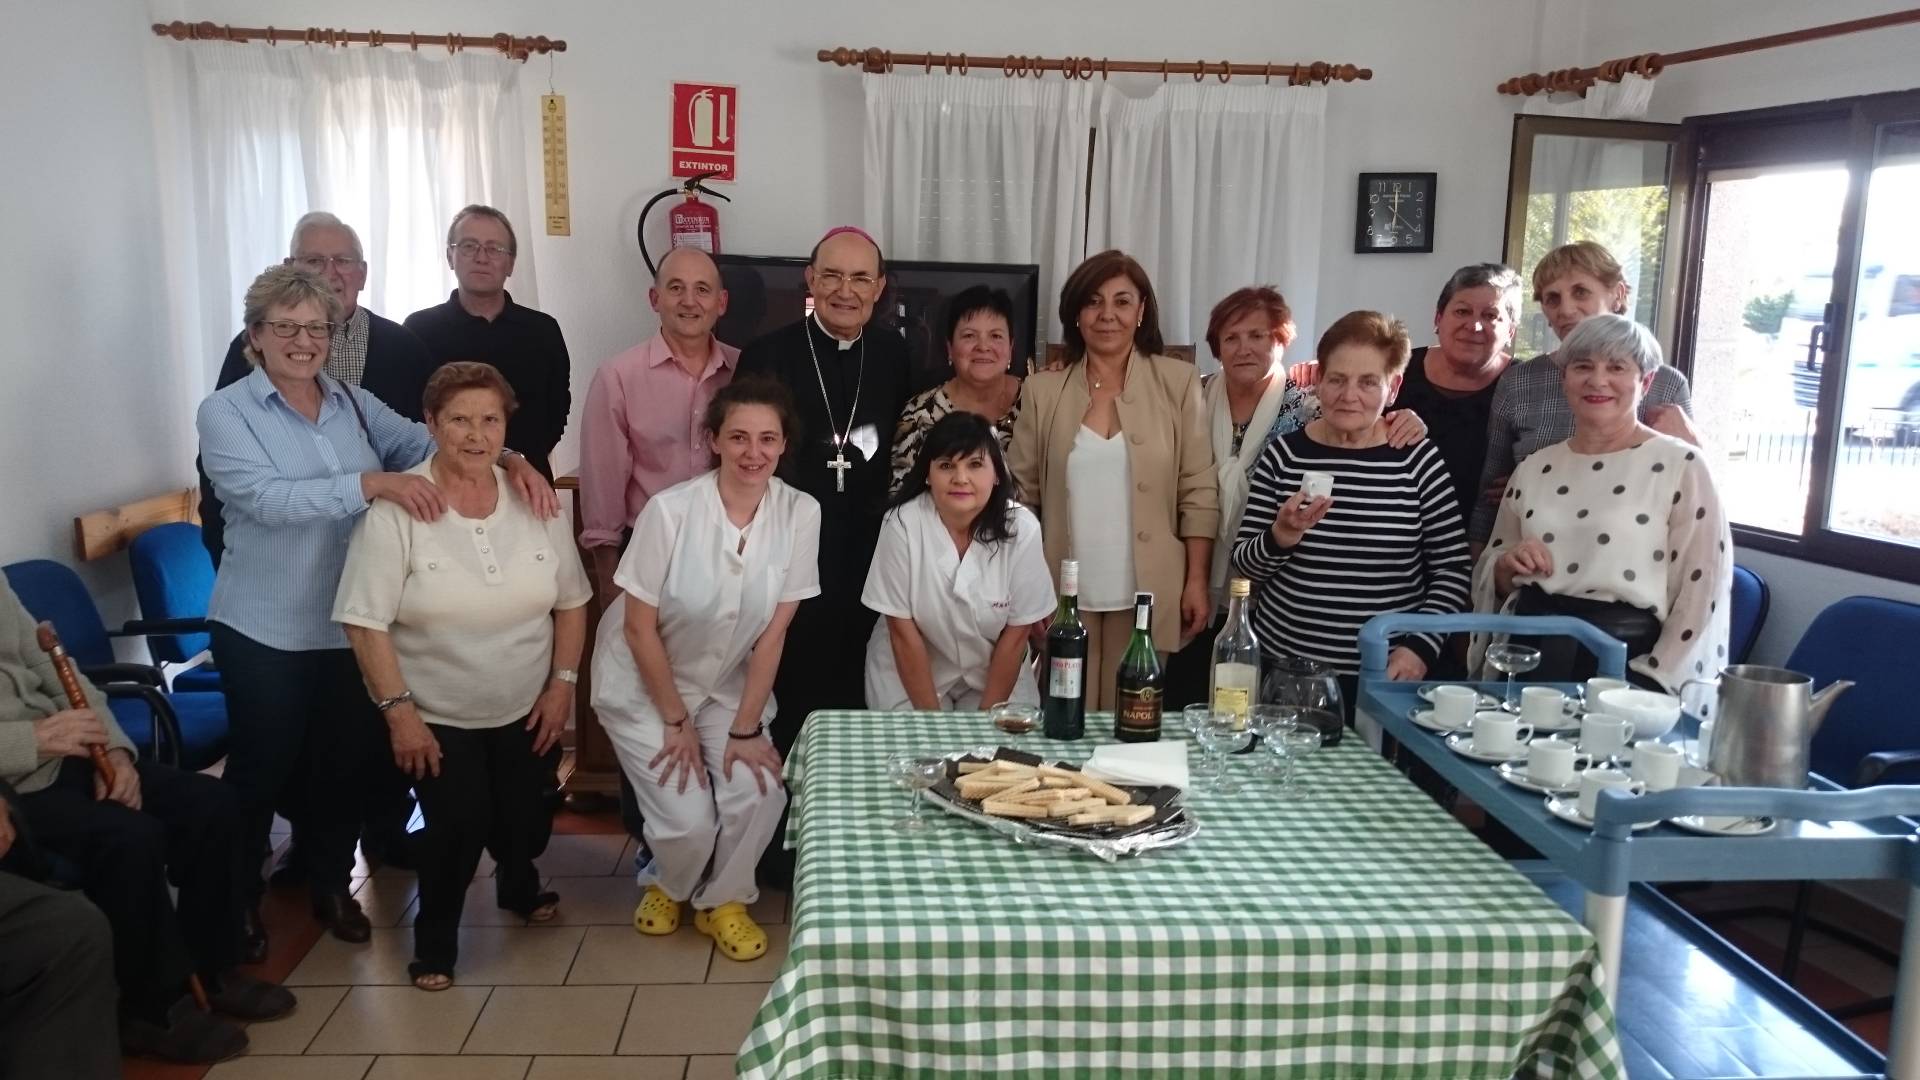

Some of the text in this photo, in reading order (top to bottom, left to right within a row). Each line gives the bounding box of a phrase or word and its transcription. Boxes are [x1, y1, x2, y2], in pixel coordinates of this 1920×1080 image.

[679, 160, 728, 172] EXTINTOR
[1378, 181, 1386, 193] 11
[1408, 182, 1413, 193] 1
[1369, 193, 1380, 204] 10
[1416, 191, 1424, 202] 2
[1368, 208, 1376, 219] 9
[1416, 207, 1423, 218] 3
[1367, 225, 1374, 236] 8
[1414, 223, 1422, 233] 4
[1405, 234, 1414, 245] 5
